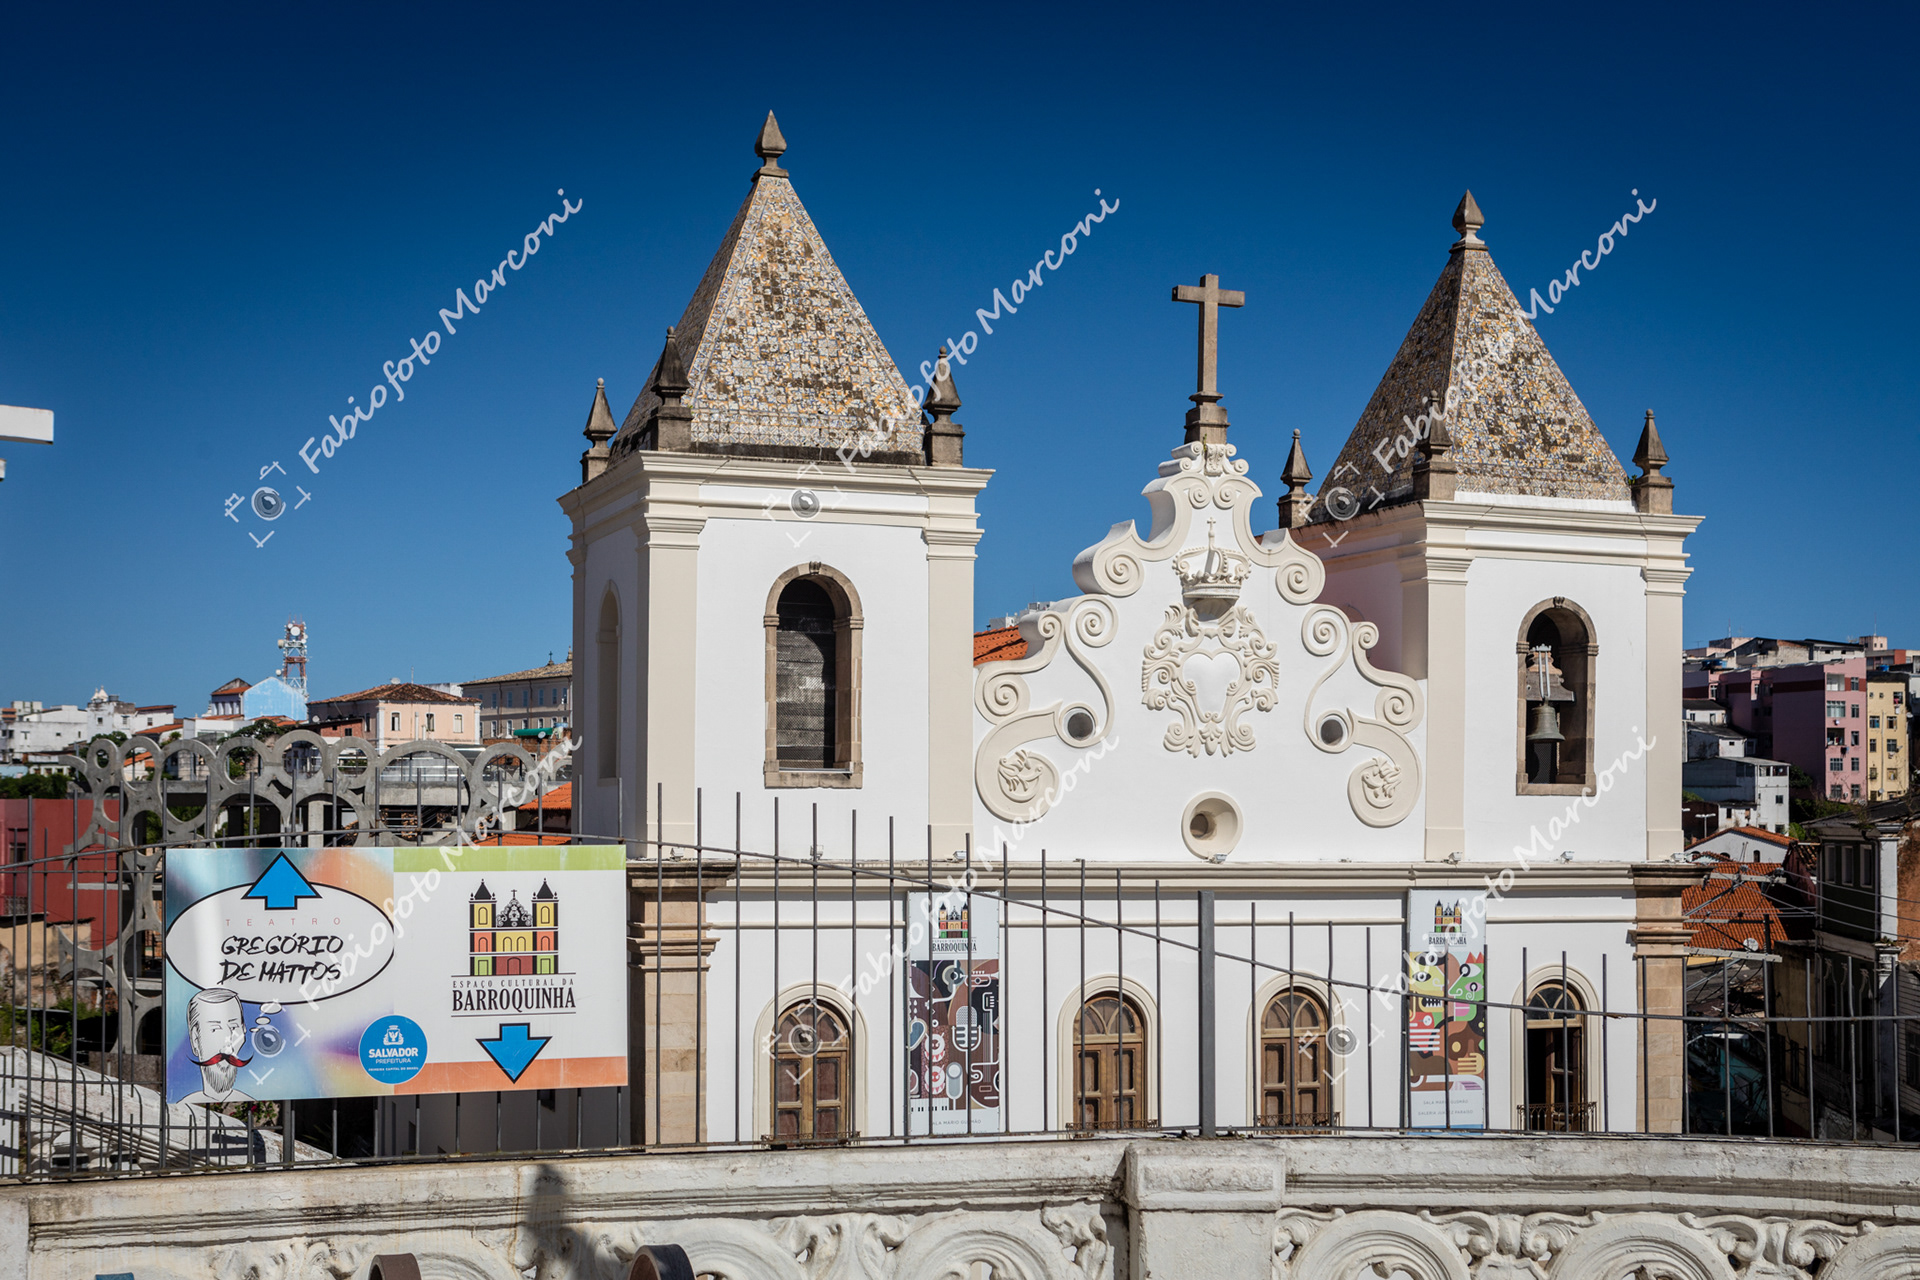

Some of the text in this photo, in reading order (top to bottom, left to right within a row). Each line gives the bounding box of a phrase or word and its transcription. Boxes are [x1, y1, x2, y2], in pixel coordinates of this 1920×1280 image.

[225, 917, 341, 926] TEATRO
[221, 932, 344, 957] GREGÓRIO
[217, 959, 342, 985] DE MATTOS
[453, 978, 574, 989] ESPAÇO CULTURAL DA
[452, 987, 576, 1013] BARROQUINHA
[368, 1047, 419, 1058] SALVADOR
